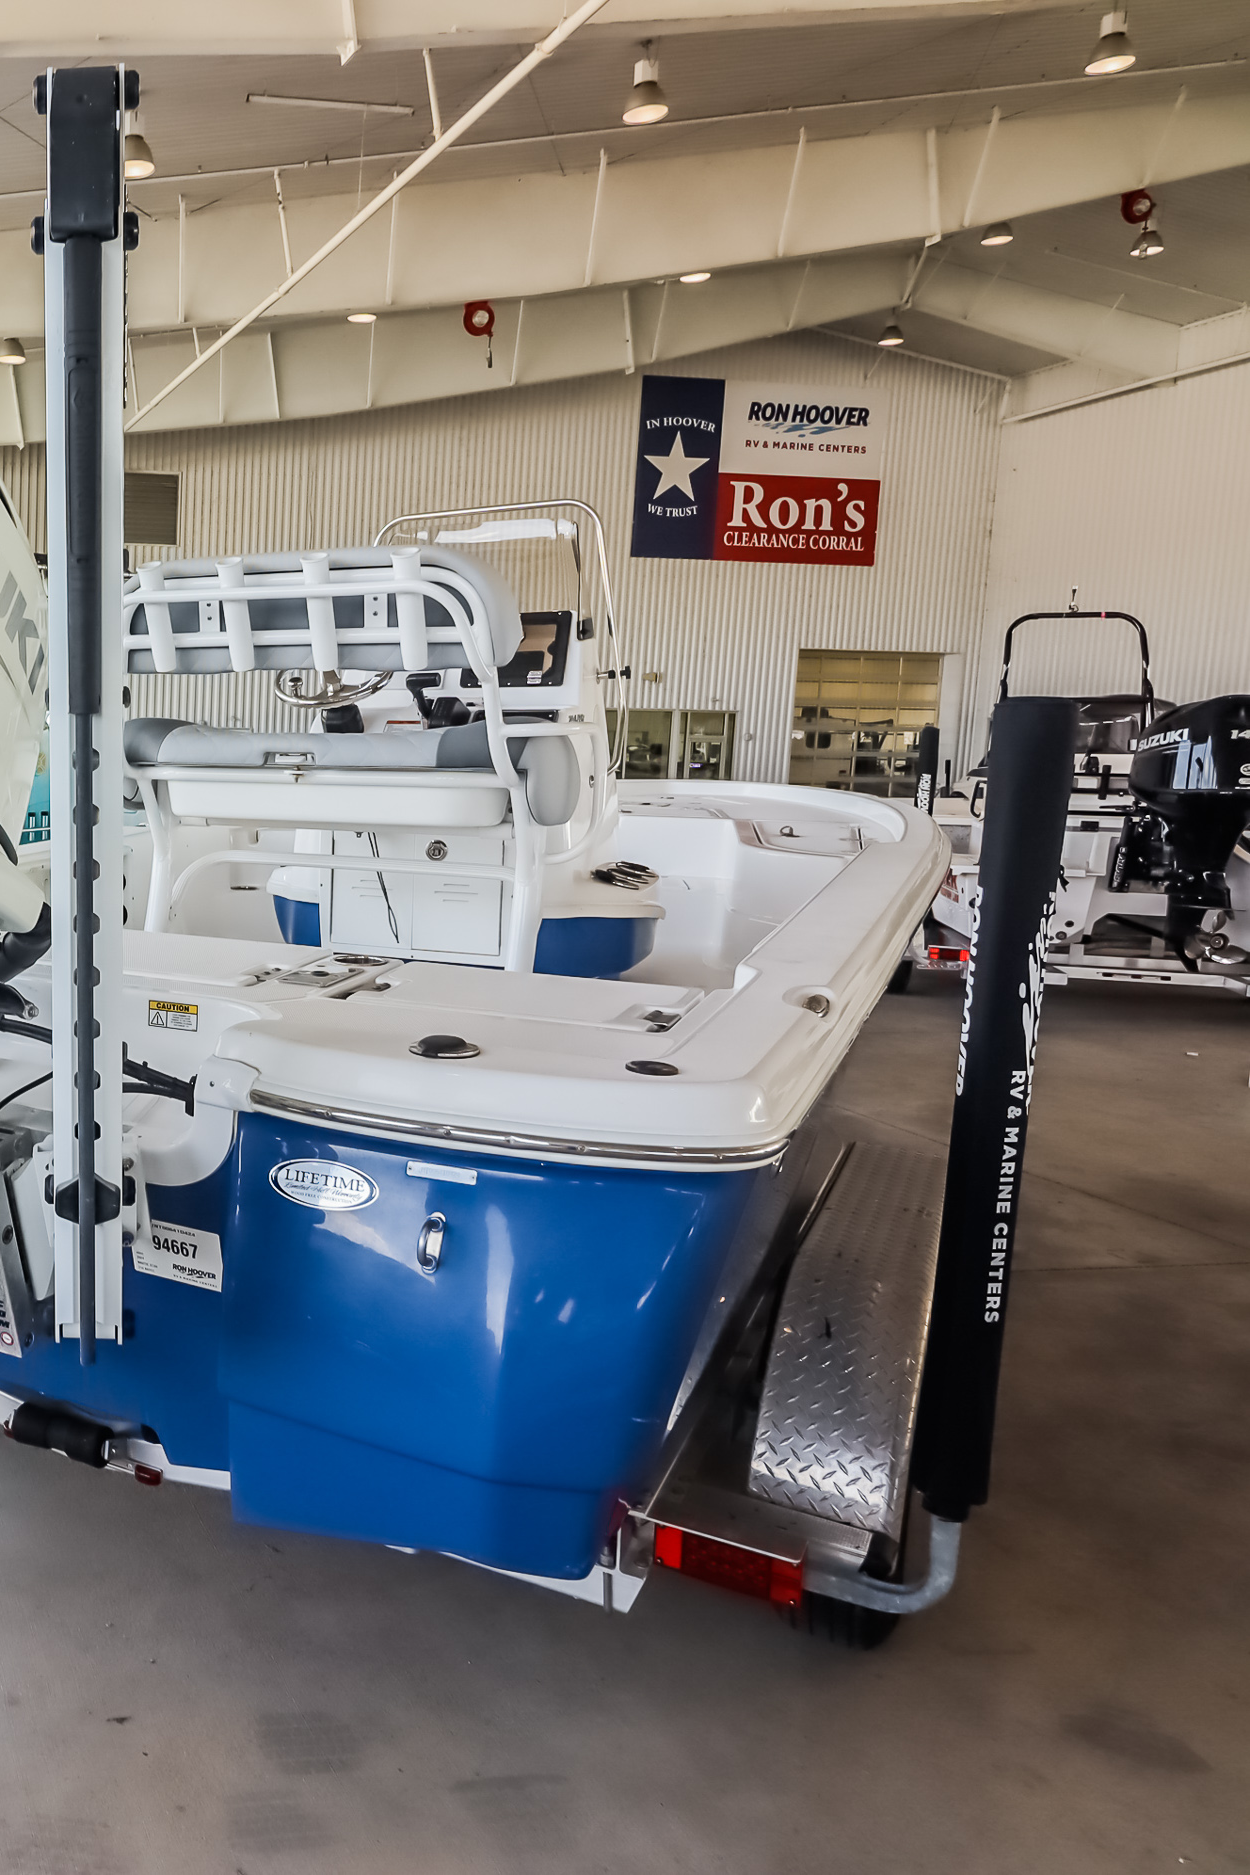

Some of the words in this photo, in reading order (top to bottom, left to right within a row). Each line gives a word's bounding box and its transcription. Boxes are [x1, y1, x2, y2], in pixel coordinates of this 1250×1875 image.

[646, 417, 660, 430] IN
[663, 416, 716, 433] HOOVER
[748, 401, 790, 423] RON
[791, 403, 870, 427] HOOVER
[745, 439, 760, 449] RV
[762, 440, 769, 449] &
[772, 441, 814, 452] MARINE
[818, 443, 867, 455] CENTERS
[647, 503, 663, 517] WE
[665, 505, 698, 518] TRUST
[726, 480, 865, 532] Ron's
[723, 531, 807, 550] CLEARANCE
[809, 534, 865, 552] CORRAL
[1137, 727, 1189, 752] SUZUKI
[156, 1002, 190, 1012] CAUTION
[1009, 1070, 1027, 1100] RV
[1007, 1105, 1022, 1119] &
[284, 1168, 365, 1192] LIFETIME
[996, 1126, 1020, 1215] MARINE
[152, 1235, 198, 1259] 94667
[172, 1263, 187, 1273] RON
[188, 1267, 217, 1280] HOOVER
[984, 1222, 1010, 1325] CENTERS
